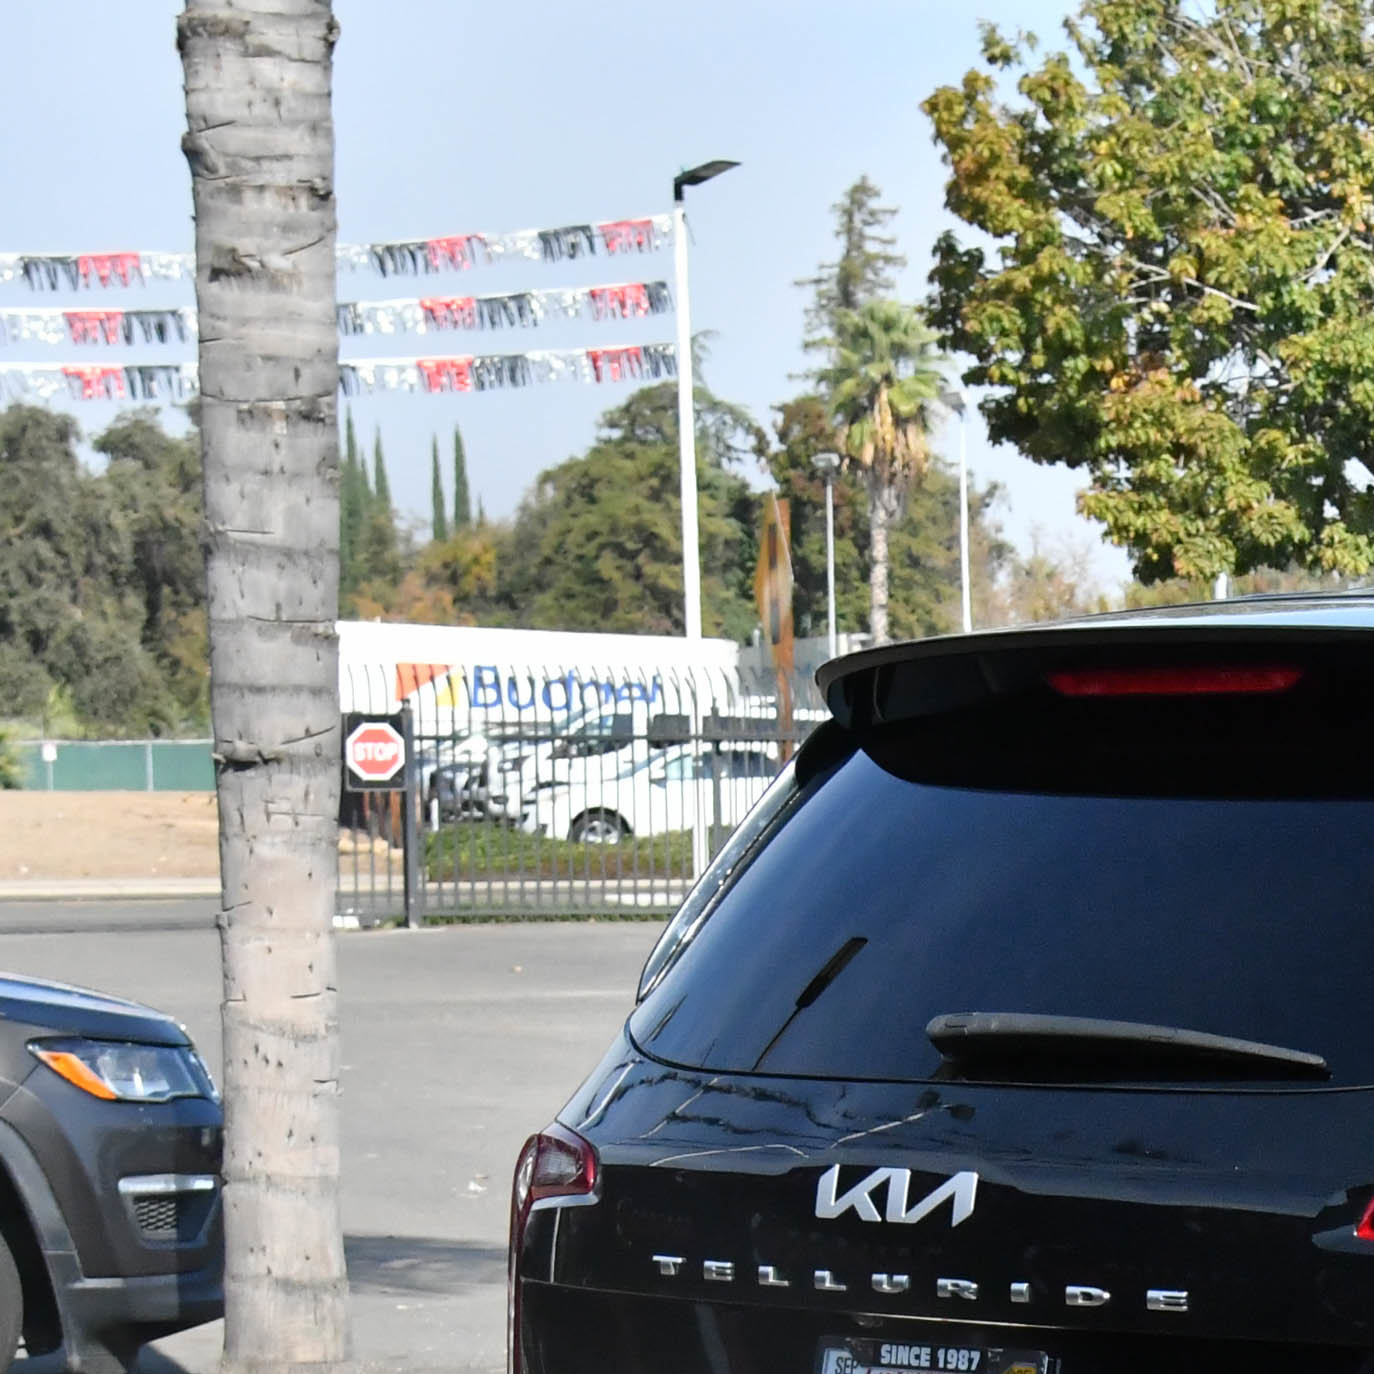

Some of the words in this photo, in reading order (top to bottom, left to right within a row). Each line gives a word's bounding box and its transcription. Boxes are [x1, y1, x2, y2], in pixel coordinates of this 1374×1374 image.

[354, 741, 399, 762] STOP
[815, 1163, 979, 1228] KIA
[651, 1254, 1189, 1313] TELLURIDE
[880, 1344, 931, 1367] SINCE
[937, 1348, 981, 1371] 1987
